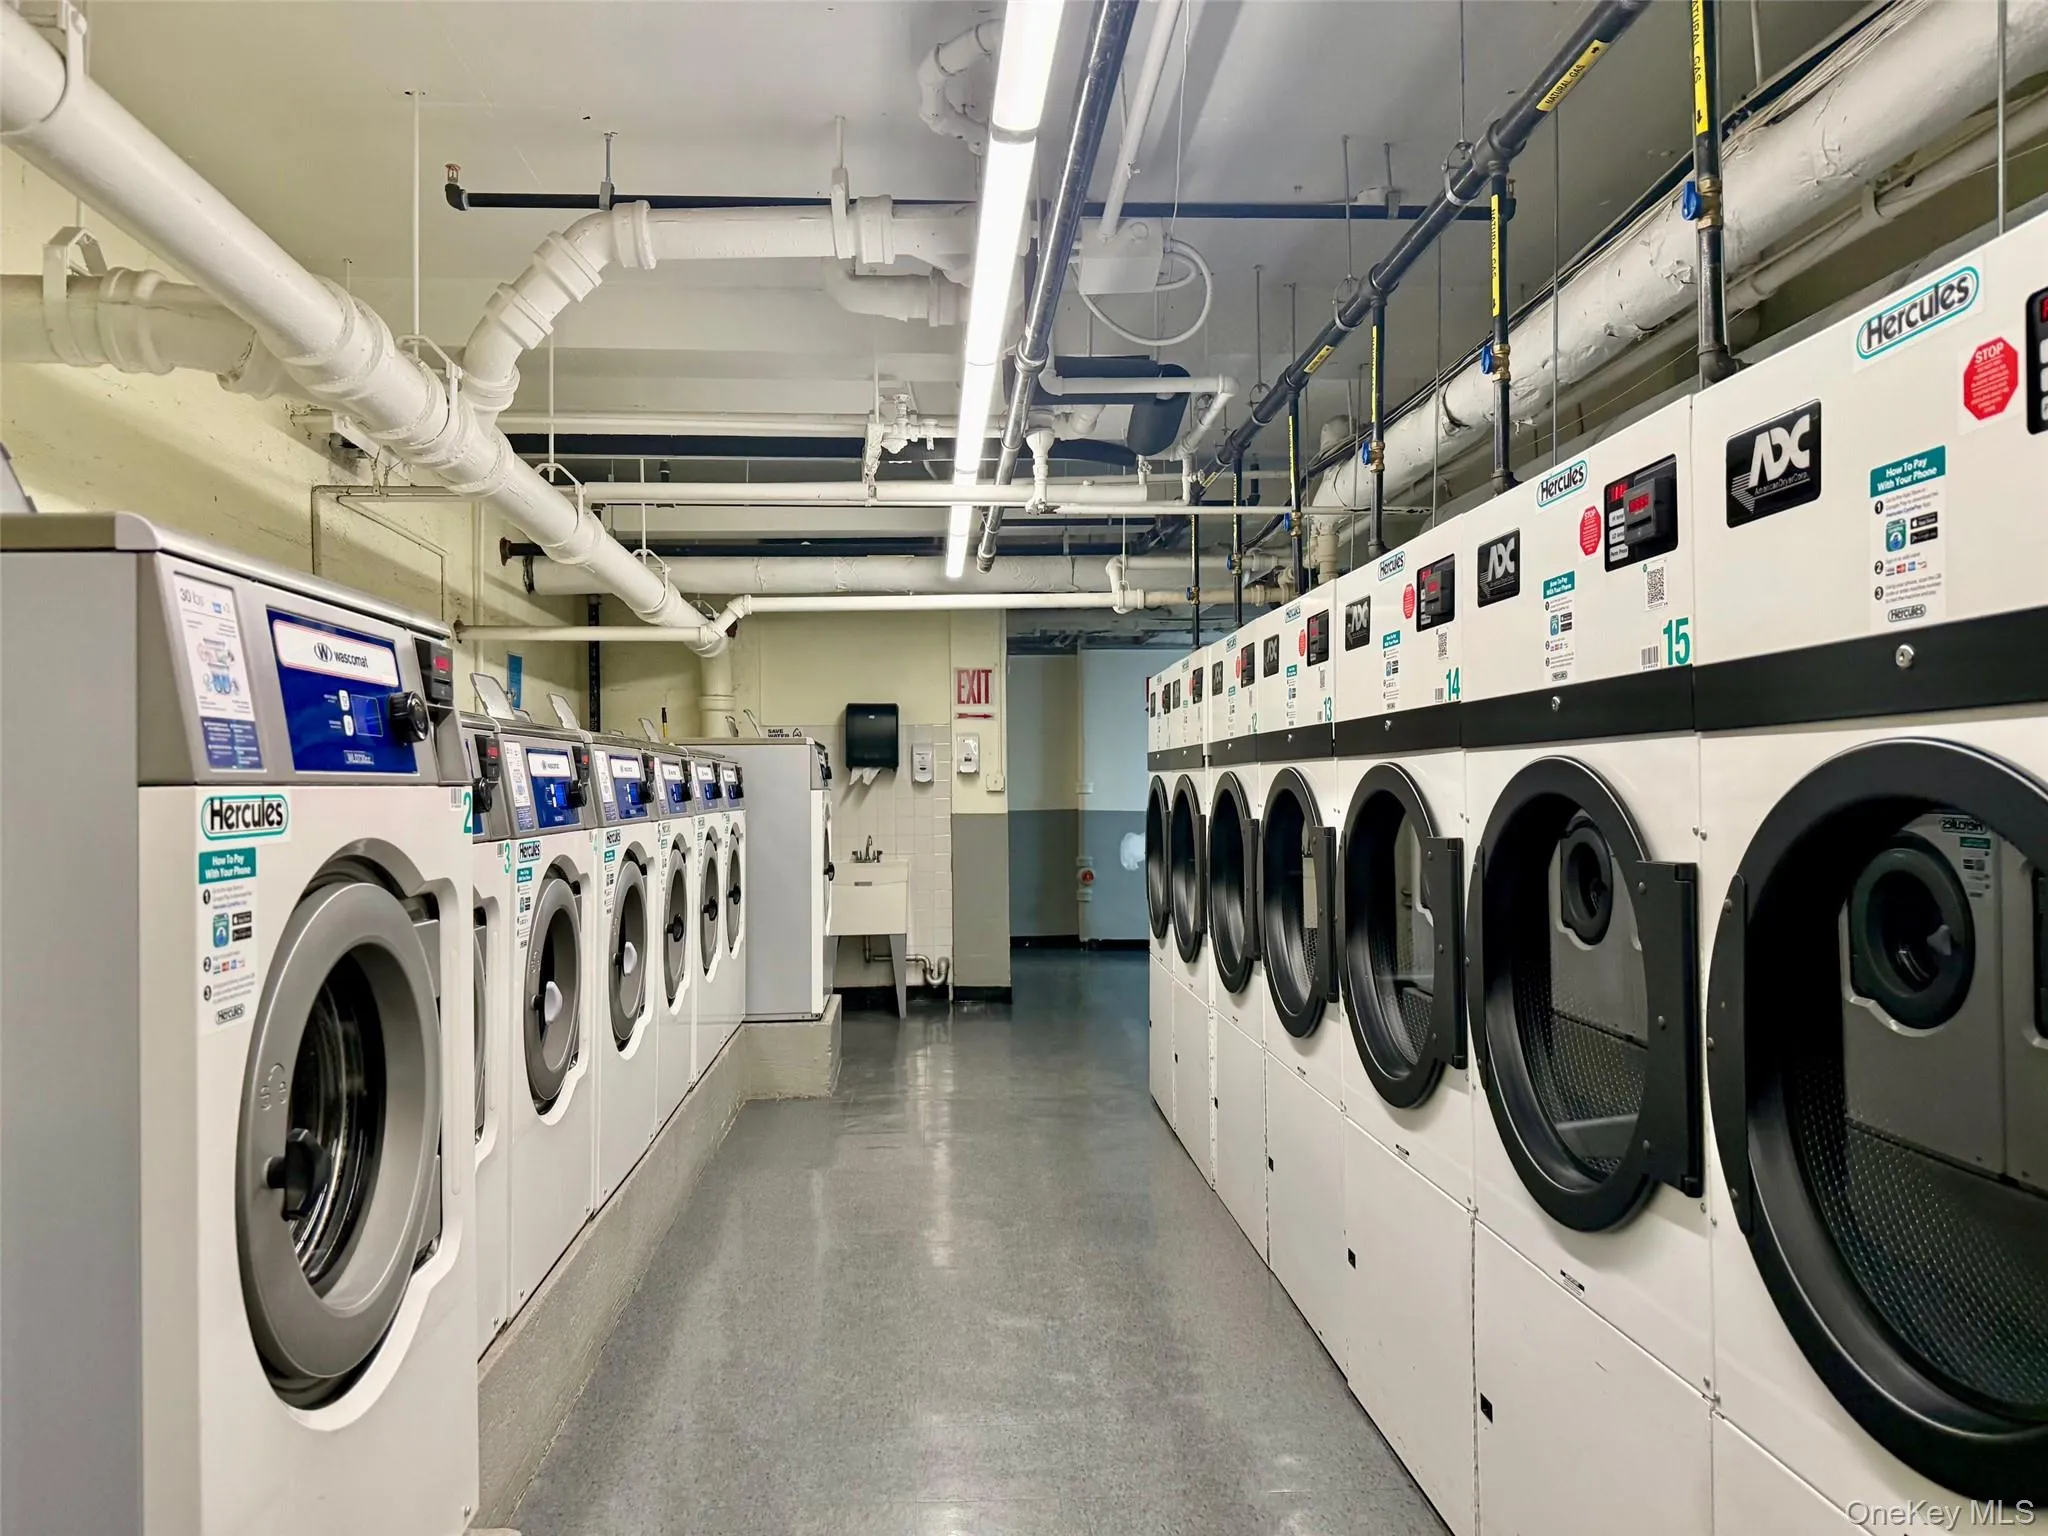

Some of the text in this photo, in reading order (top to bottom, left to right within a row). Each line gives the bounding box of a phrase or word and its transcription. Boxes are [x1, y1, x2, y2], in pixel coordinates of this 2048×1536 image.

[1545, 64, 1585, 104] NATURAL GAS
[1867, 276, 1970, 350] Hercules
[1975, 341, 2005, 364] STOP
[1749, 413, 1811, 488] ADC
[1540, 465, 1585, 502] Hercules
[1877, 466, 1938, 492] With Your Phone
[1885, 457, 1927, 478] How To Pay
[1380, 554, 1404, 578] Hercules
[1487, 537, 1515, 582] ADC
[1891, 605, 1923, 620] Hercules
[1662, 617, 1691, 666] 15
[334, 651, 369, 668] wascomat
[957, 669, 992, 704] EXIT
[1446, 667, 1460, 701] 14
[1323, 696, 1332, 721] 13
[210, 796, 284, 831] Hercules
[463, 791, 472, 834] 2
[205, 866, 251, 879] With Your Phone
[212, 853, 245, 866] How To Pay
[504, 842, 511, 873] 3
